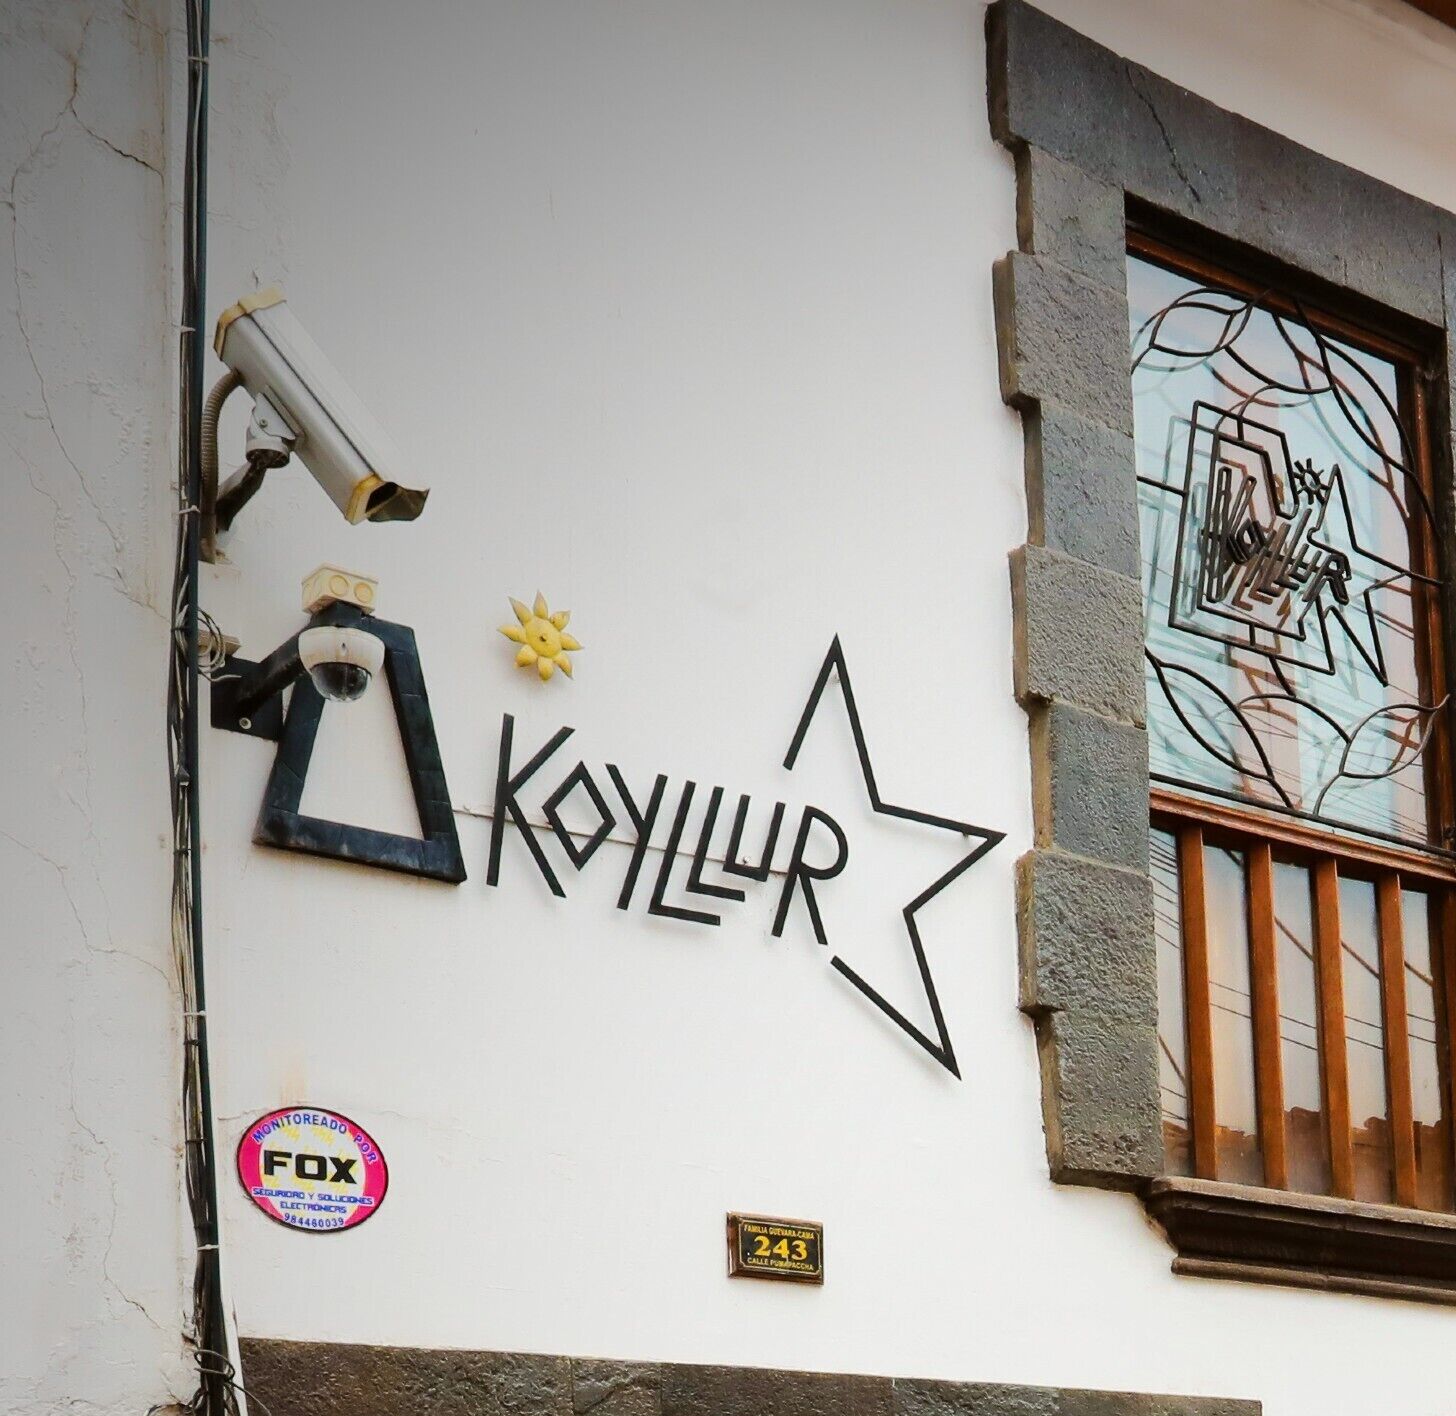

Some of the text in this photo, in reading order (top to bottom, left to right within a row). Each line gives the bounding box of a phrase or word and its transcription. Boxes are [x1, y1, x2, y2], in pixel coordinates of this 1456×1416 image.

[486, 712, 849, 946] KOYLLUR
[252, 1113, 377, 1163] MONITOREADO POR
[263, 1149, 358, 1185] FOX
[252, 1187, 305, 1200] SEGURIDAD
[317, 1193, 373, 1205] SOLUCIONES
[744, 1224, 768, 1234] FAMILIA
[754, 1235, 808, 1261] 243
[747, 1257, 769, 1266] CALLE
